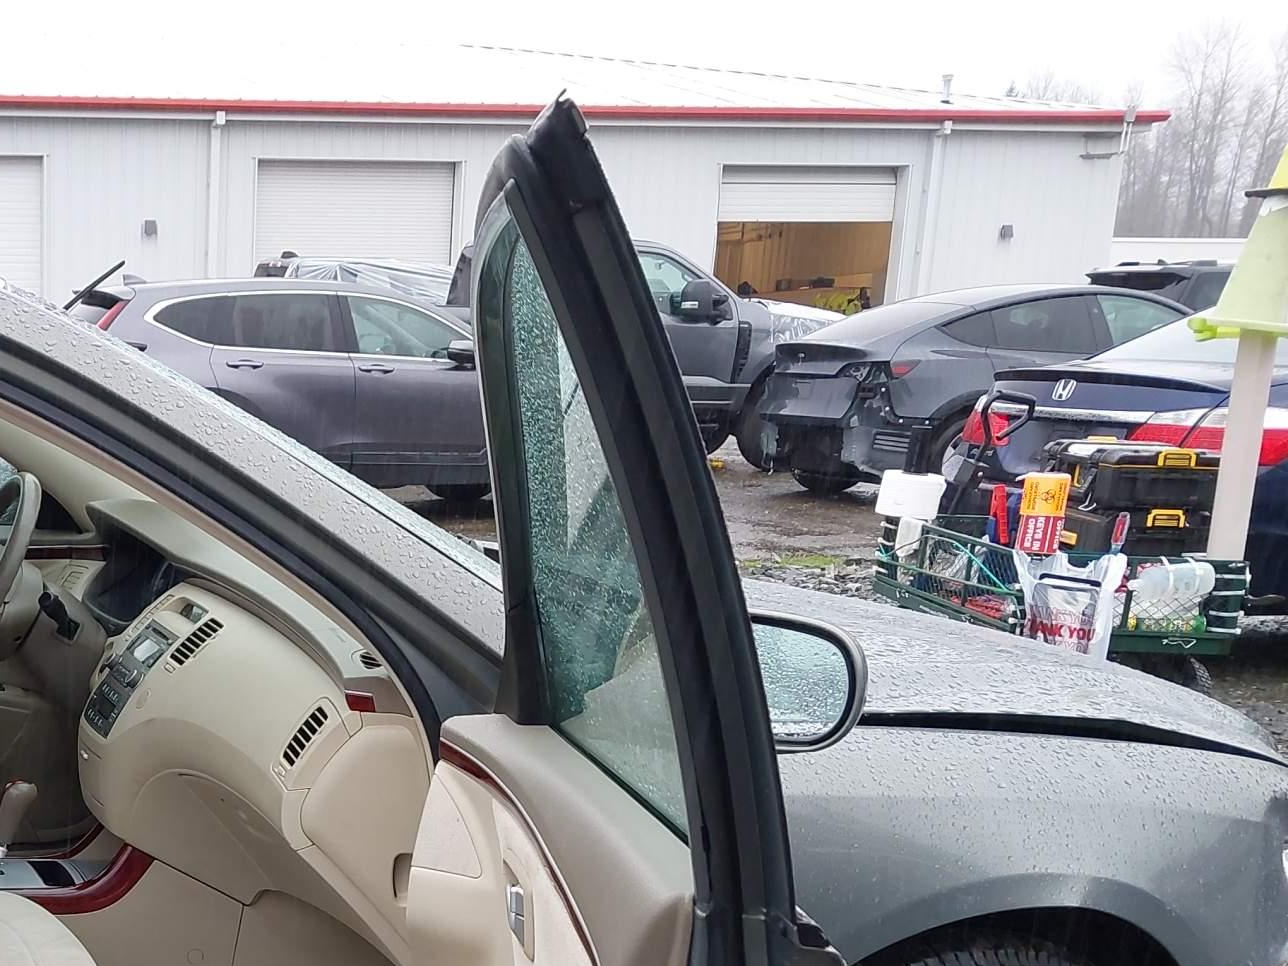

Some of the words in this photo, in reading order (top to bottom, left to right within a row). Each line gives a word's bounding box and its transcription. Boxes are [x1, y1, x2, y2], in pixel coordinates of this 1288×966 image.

[1024, 518, 1036, 547] OFFICE
[1034, 517, 1046, 539] KEYS
[1032, 541, 1041, 550] IN
[1068, 626, 1096, 641] YOU
